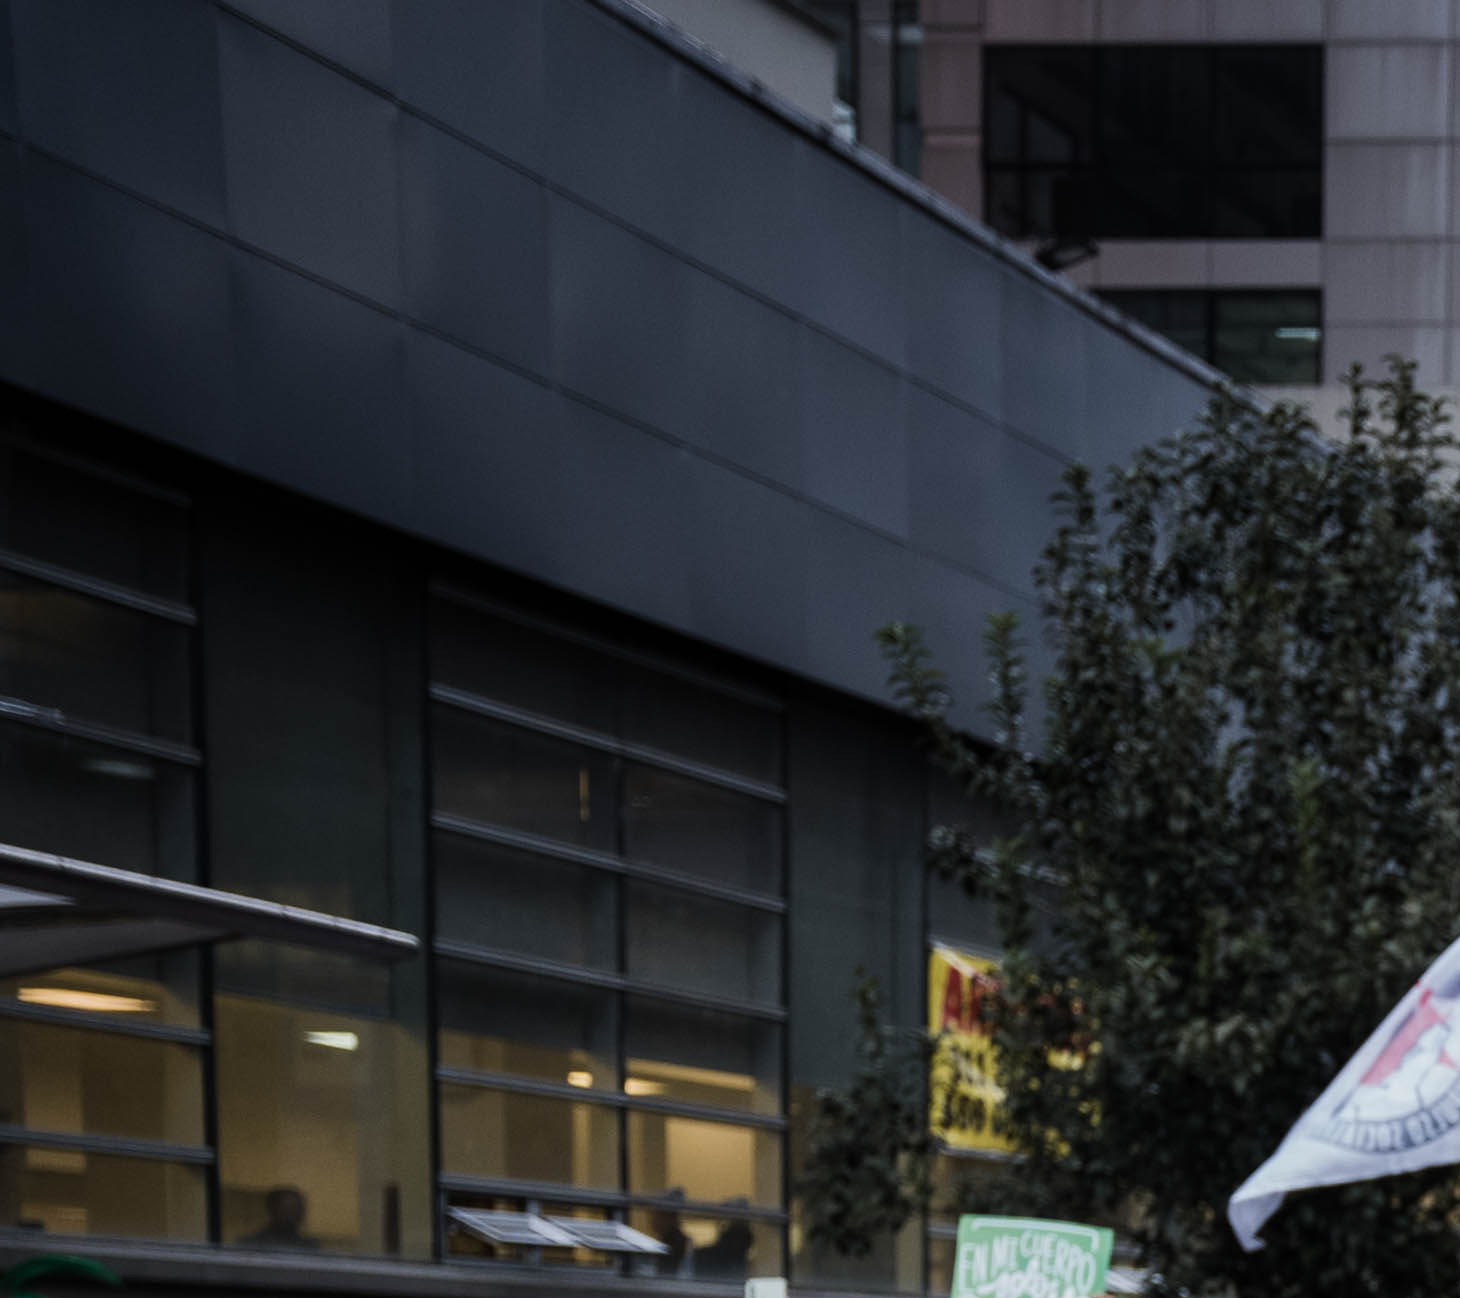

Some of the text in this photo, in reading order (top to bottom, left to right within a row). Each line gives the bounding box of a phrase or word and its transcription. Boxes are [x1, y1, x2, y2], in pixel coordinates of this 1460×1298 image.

[959, 1230, 1096, 1293] EN MI CUERPO
